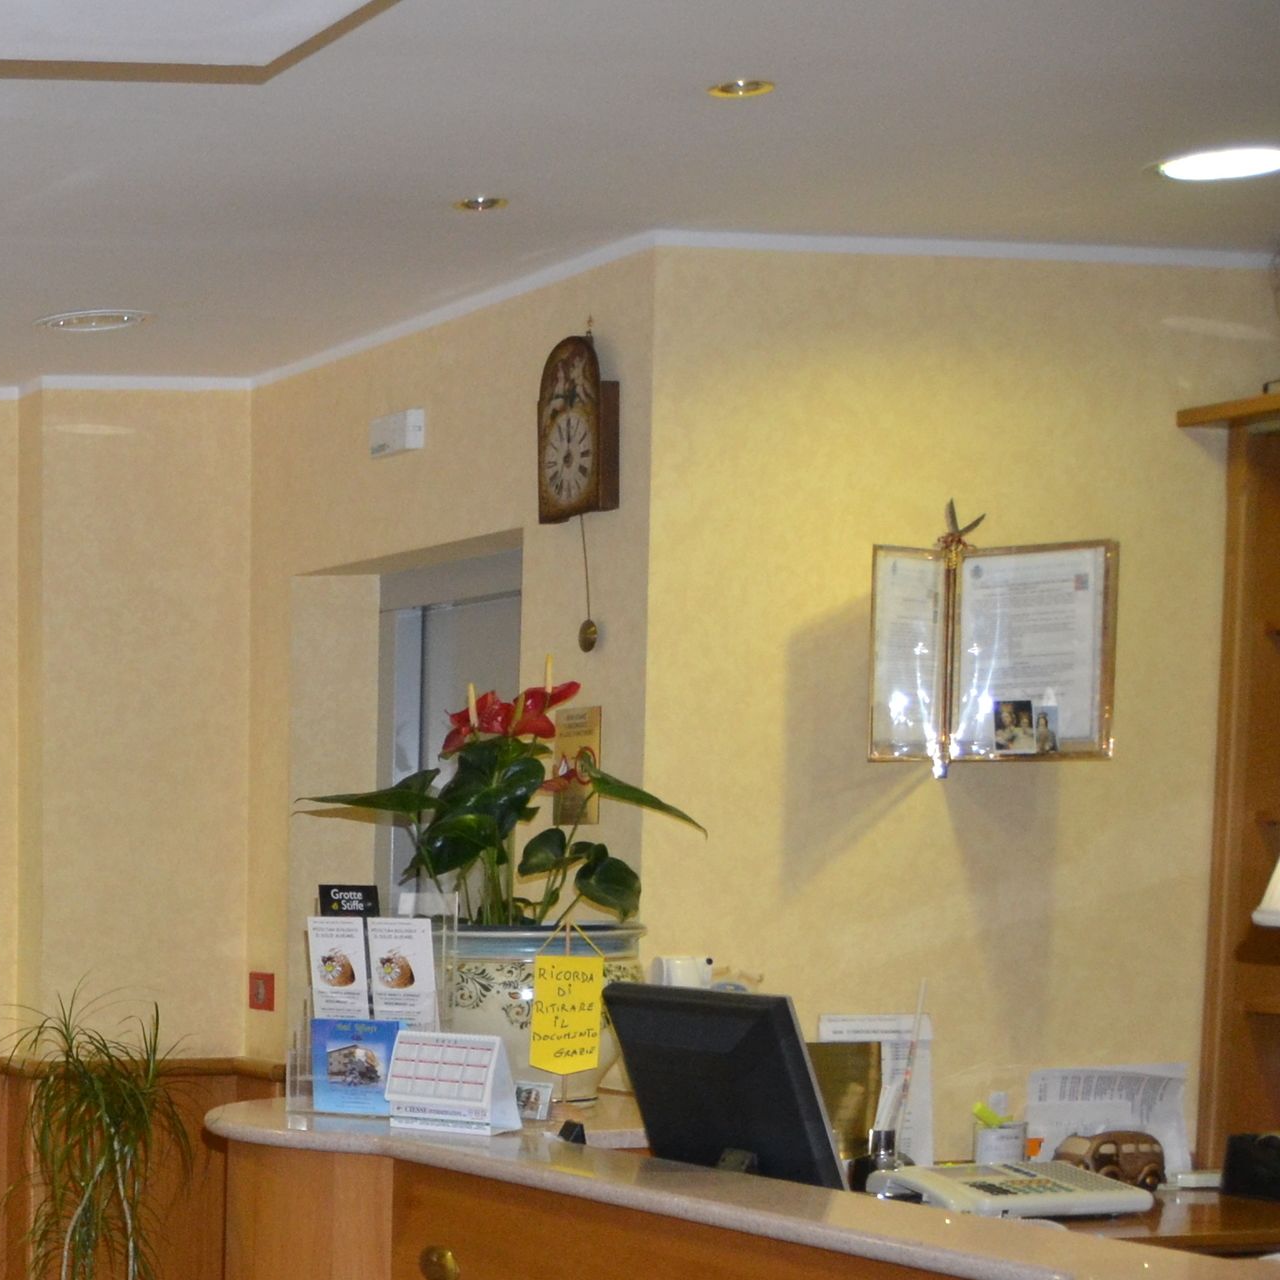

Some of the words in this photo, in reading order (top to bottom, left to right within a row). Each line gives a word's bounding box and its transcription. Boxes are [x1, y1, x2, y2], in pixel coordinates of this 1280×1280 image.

[330, 888, 363, 900] Grotte
[341, 900, 365, 911] Stiffe
[534, 1000, 594, 1014] RITIRARE
